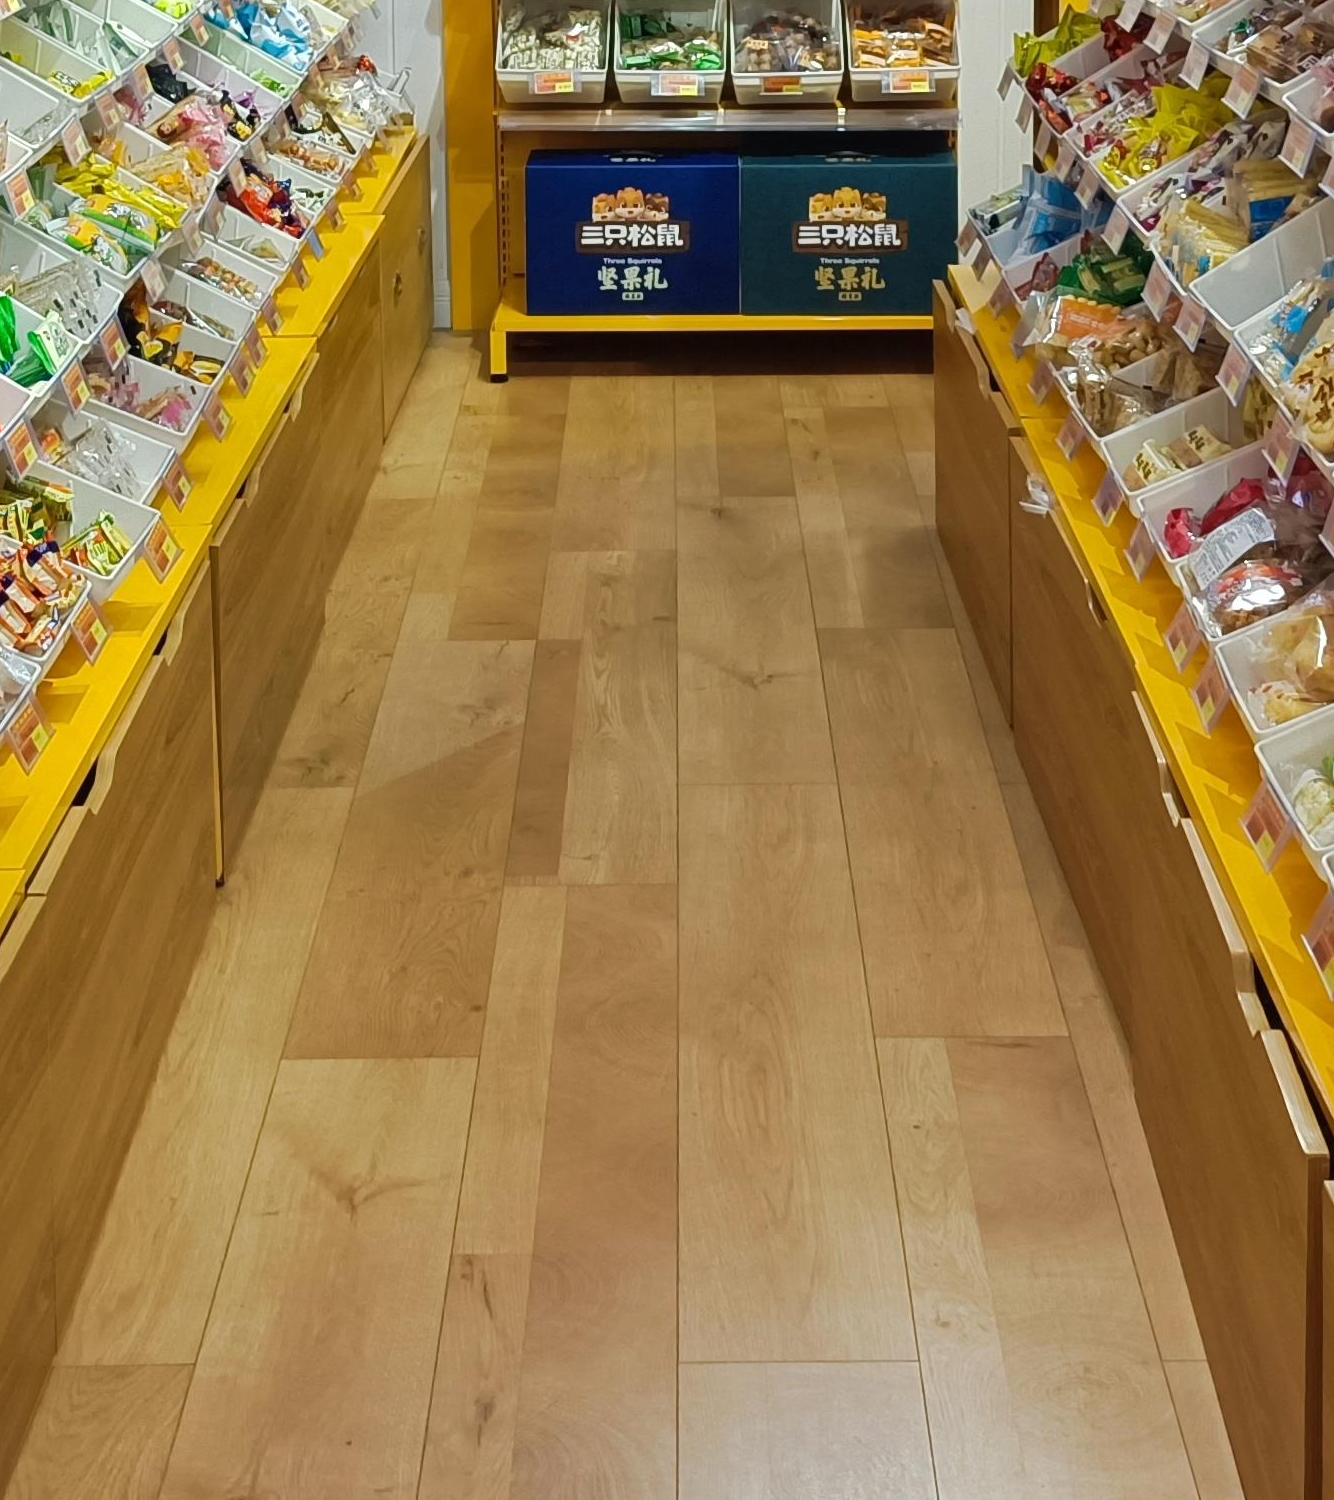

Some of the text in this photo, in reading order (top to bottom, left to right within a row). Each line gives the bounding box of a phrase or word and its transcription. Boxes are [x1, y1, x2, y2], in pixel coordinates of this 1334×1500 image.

[580, 223, 685, 248] 三只松鼠
[797, 223, 902, 248] 三只松鼠
[597, 265, 669, 291] 坚果礼
[813, 265, 886, 291] 坚果礼
